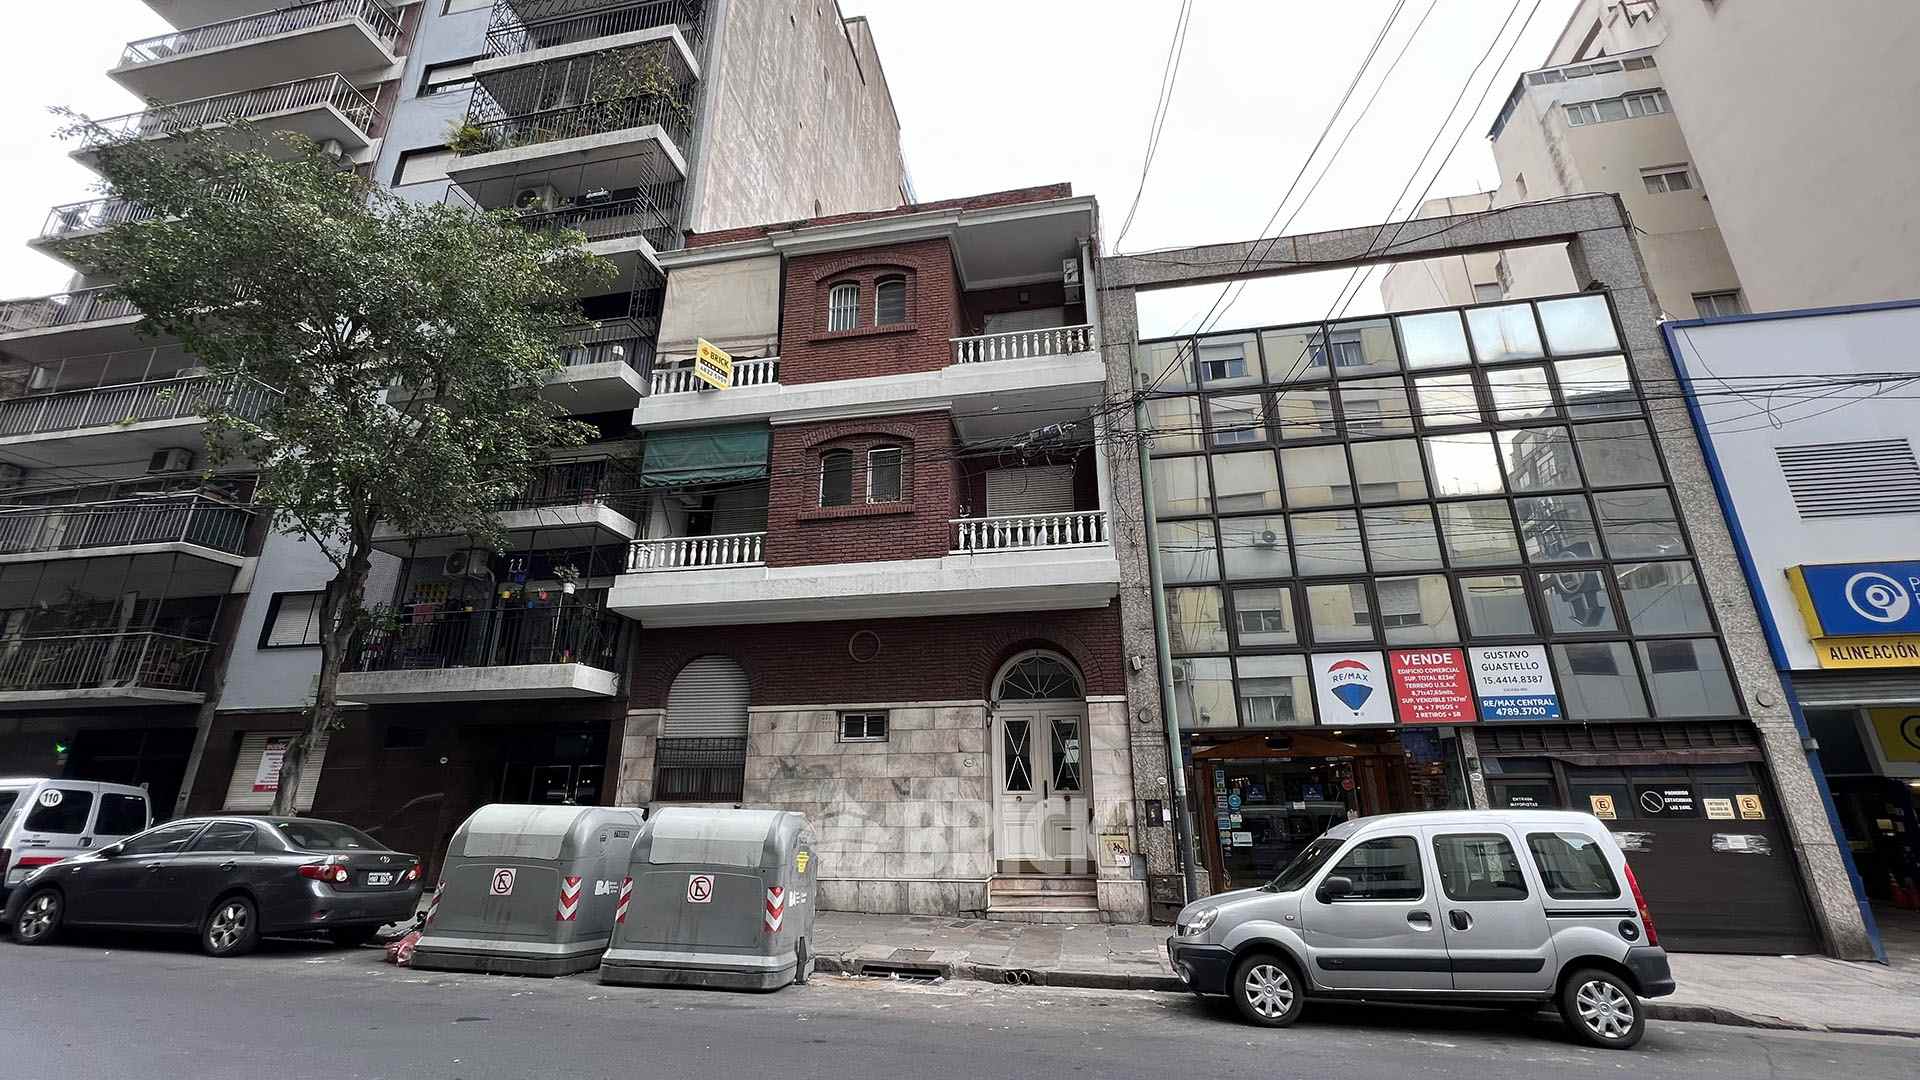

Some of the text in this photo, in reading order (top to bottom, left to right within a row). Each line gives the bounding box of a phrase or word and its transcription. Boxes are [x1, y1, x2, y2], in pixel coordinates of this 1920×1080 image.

[711, 351, 729, 369] BRICK
[1483, 651, 1529, 660] GUSTAVO
[1829, 641, 1920, 660] ALINEACIÓN
[1400, 653, 1453, 665] VENDE
[1481, 662, 1539, 671] GUASTELLO
[1332, 672, 1369, 683] RE/MAX
[1483, 675, 1543, 685] 15.4414.8387
[1483, 698, 1555, 707] RE/MAX CENTRAL
[1496, 707, 1546, 716] 4789.3700
[43, 793, 59, 803] 110
